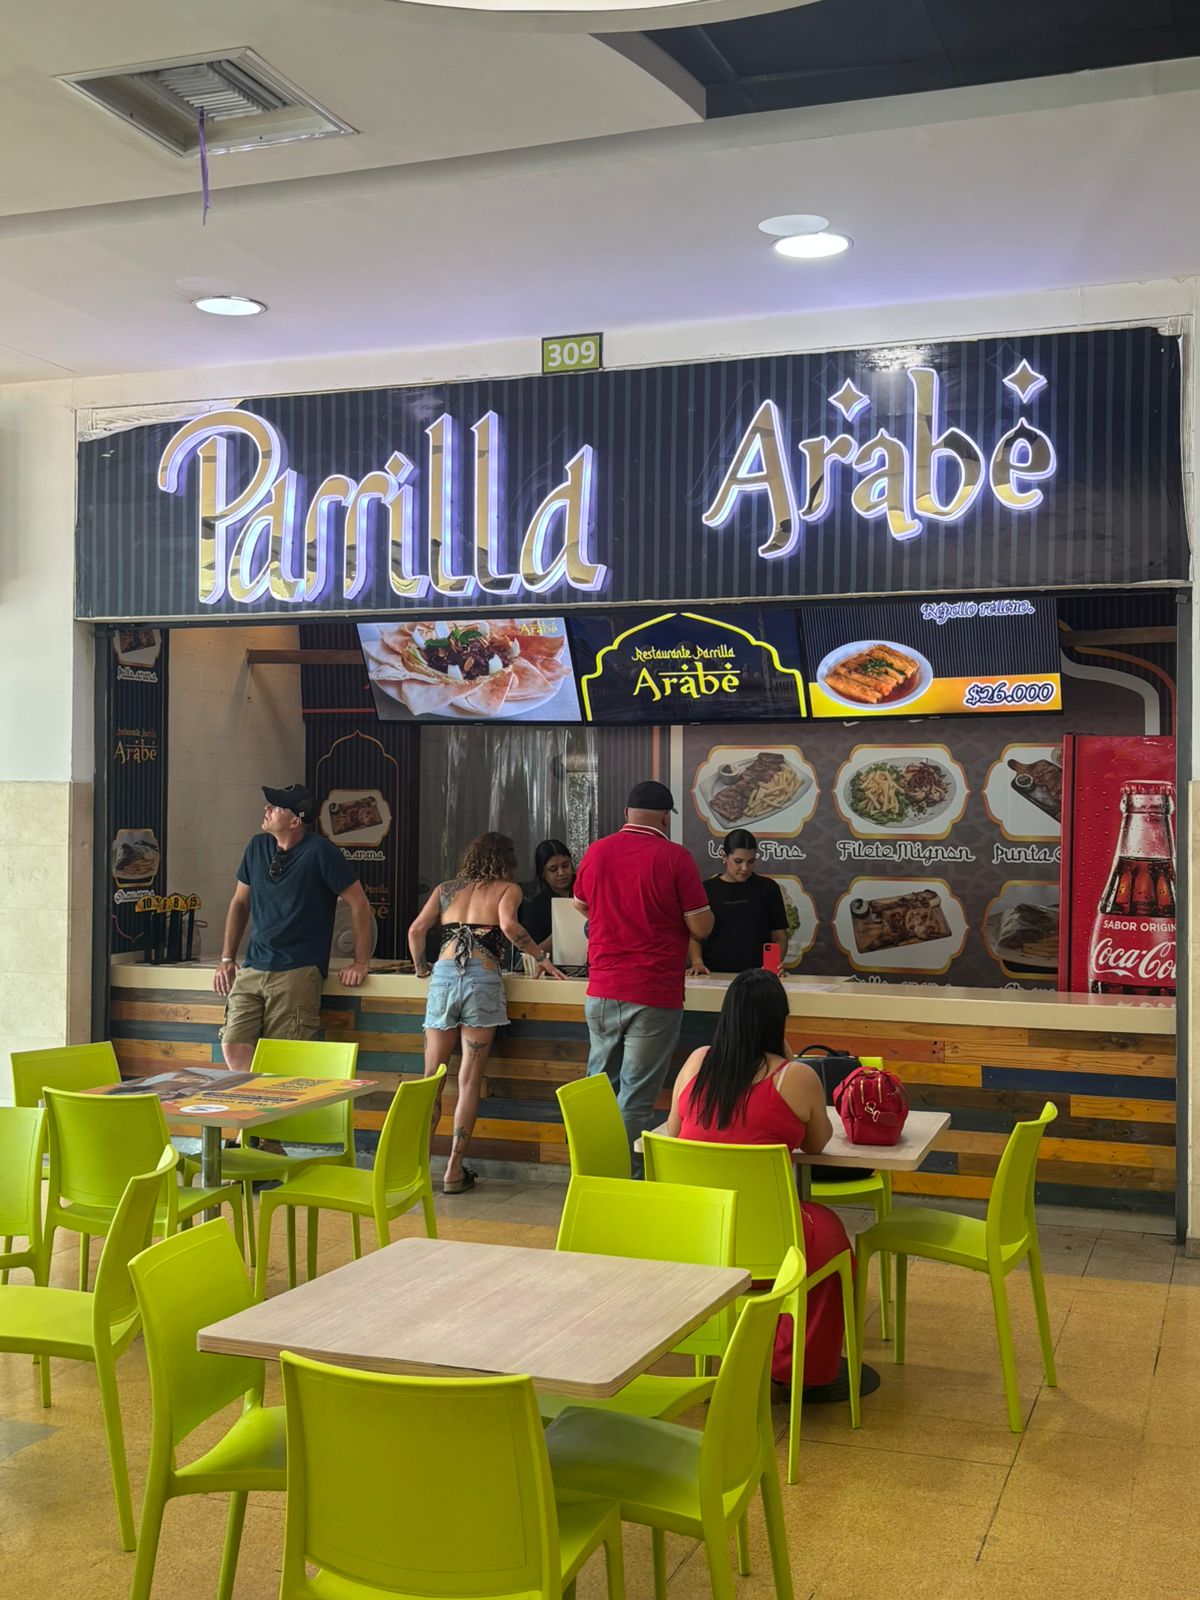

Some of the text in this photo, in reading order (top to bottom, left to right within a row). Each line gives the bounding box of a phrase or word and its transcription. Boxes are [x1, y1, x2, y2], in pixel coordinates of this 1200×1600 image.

[547, 341, 596, 367] 309
[158, 408, 608, 605] Parrilla
[921, 602, 978, 625] Repollo
[631, 644, 736, 662] Restaurante Parrilla
[963, 680, 1055, 708] $26.000
[836, 840, 898, 861] Filete
[992, 843, 1054, 864] Punta
[1103, 920, 1137, 931] SABOR
